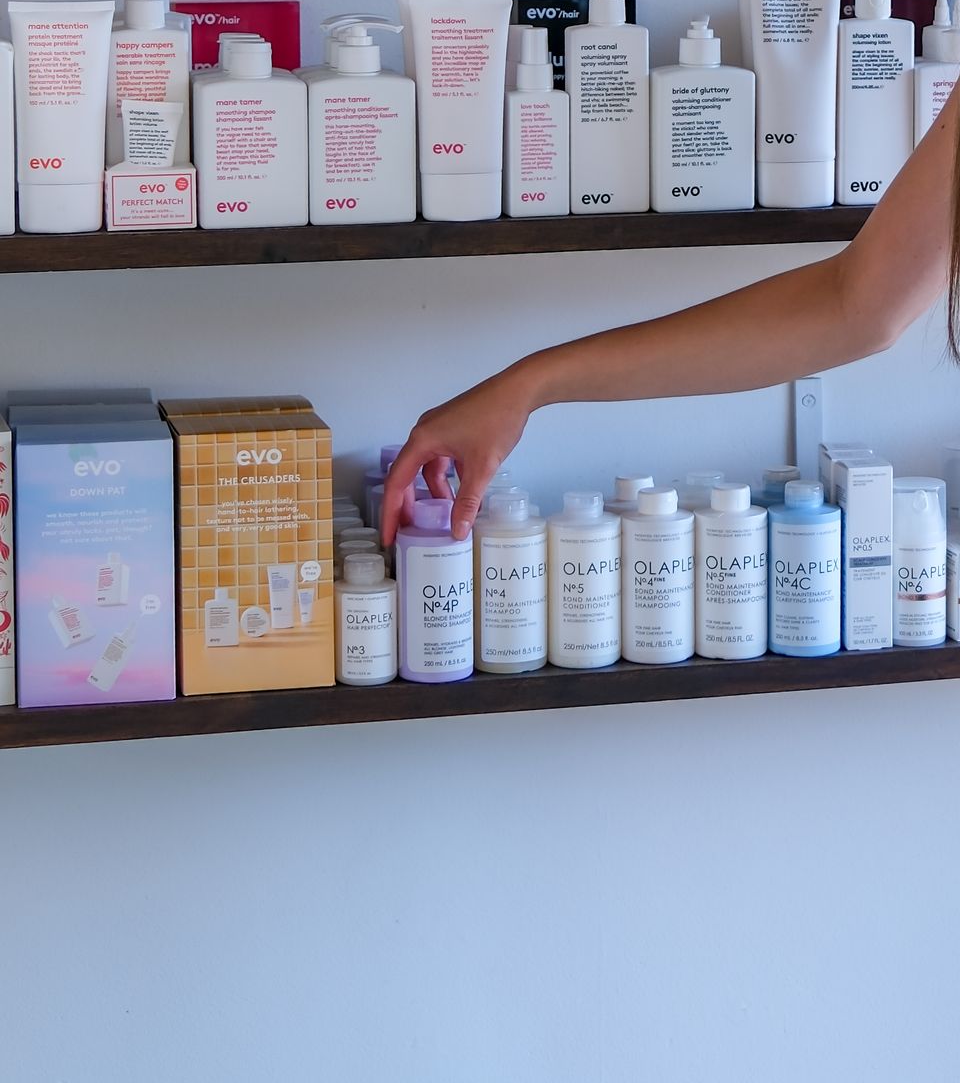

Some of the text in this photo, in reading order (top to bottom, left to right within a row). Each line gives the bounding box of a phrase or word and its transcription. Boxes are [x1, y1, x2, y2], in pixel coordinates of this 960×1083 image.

[700, 86, 729, 95] gluttony
[218, 475, 300, 486] THE CRUSADERS
[70, 487, 124, 497] DOWN PAT
[852, 536, 890, 545] OLAPLEX
[775, 558, 838, 574] OLAPLEX
[347, 612, 392, 623] OLAPLEX
